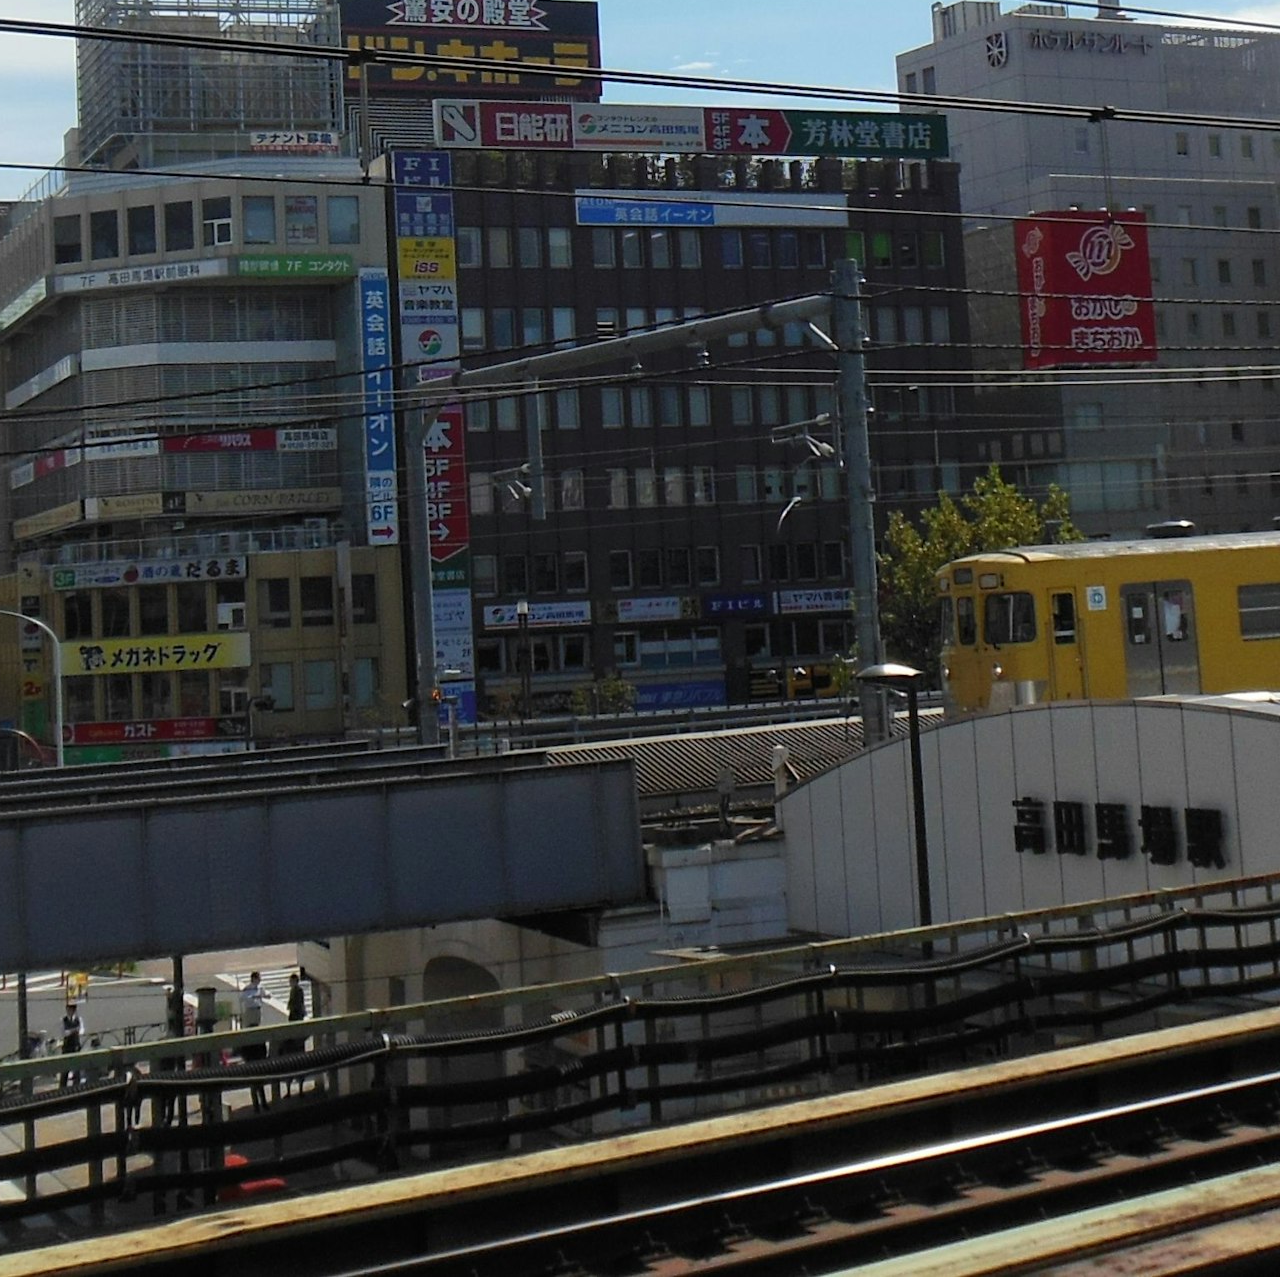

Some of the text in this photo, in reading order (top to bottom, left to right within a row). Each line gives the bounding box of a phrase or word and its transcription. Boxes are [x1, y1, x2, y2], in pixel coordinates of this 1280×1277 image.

[1030, 28, 1155, 55] ホテルサンルート
[495, 112, 569, 142] 日能研
[711, 113, 730, 125] 5F
[596, 124, 700, 135] メニコン高田馬場
[712, 125, 731, 137] 4F
[737, 114, 771, 150] 本
[801, 119, 932, 150] 芳林堂書店
[256, 132, 332, 144] テナント募集
[713, 138, 732, 150] 3F
[614, 207, 713, 221] 英会話イーオン
[287, 260, 303, 272] 7F
[309, 260, 351, 272] コンタクト
[80, 265, 200, 288] 7F 高田馬場駅前眼科
[418, 285, 454, 295] ヤマハ
[404, 299, 454, 311] 音楽教室
[1072, 326, 1143, 352] まちおか
[365, 290, 389, 457] 英会話イーオン
[372, 504, 395, 521] 6F
[186, 559, 242, 579] だるま
[55, 572, 75, 586] 3F
[507, 609, 585, 621] メコン高田馬場
[110, 641, 223, 667] メガネドラッグ
[123, 723, 157, 739] ガスト
[1012, 796, 1228, 869] 高田馬場駅
